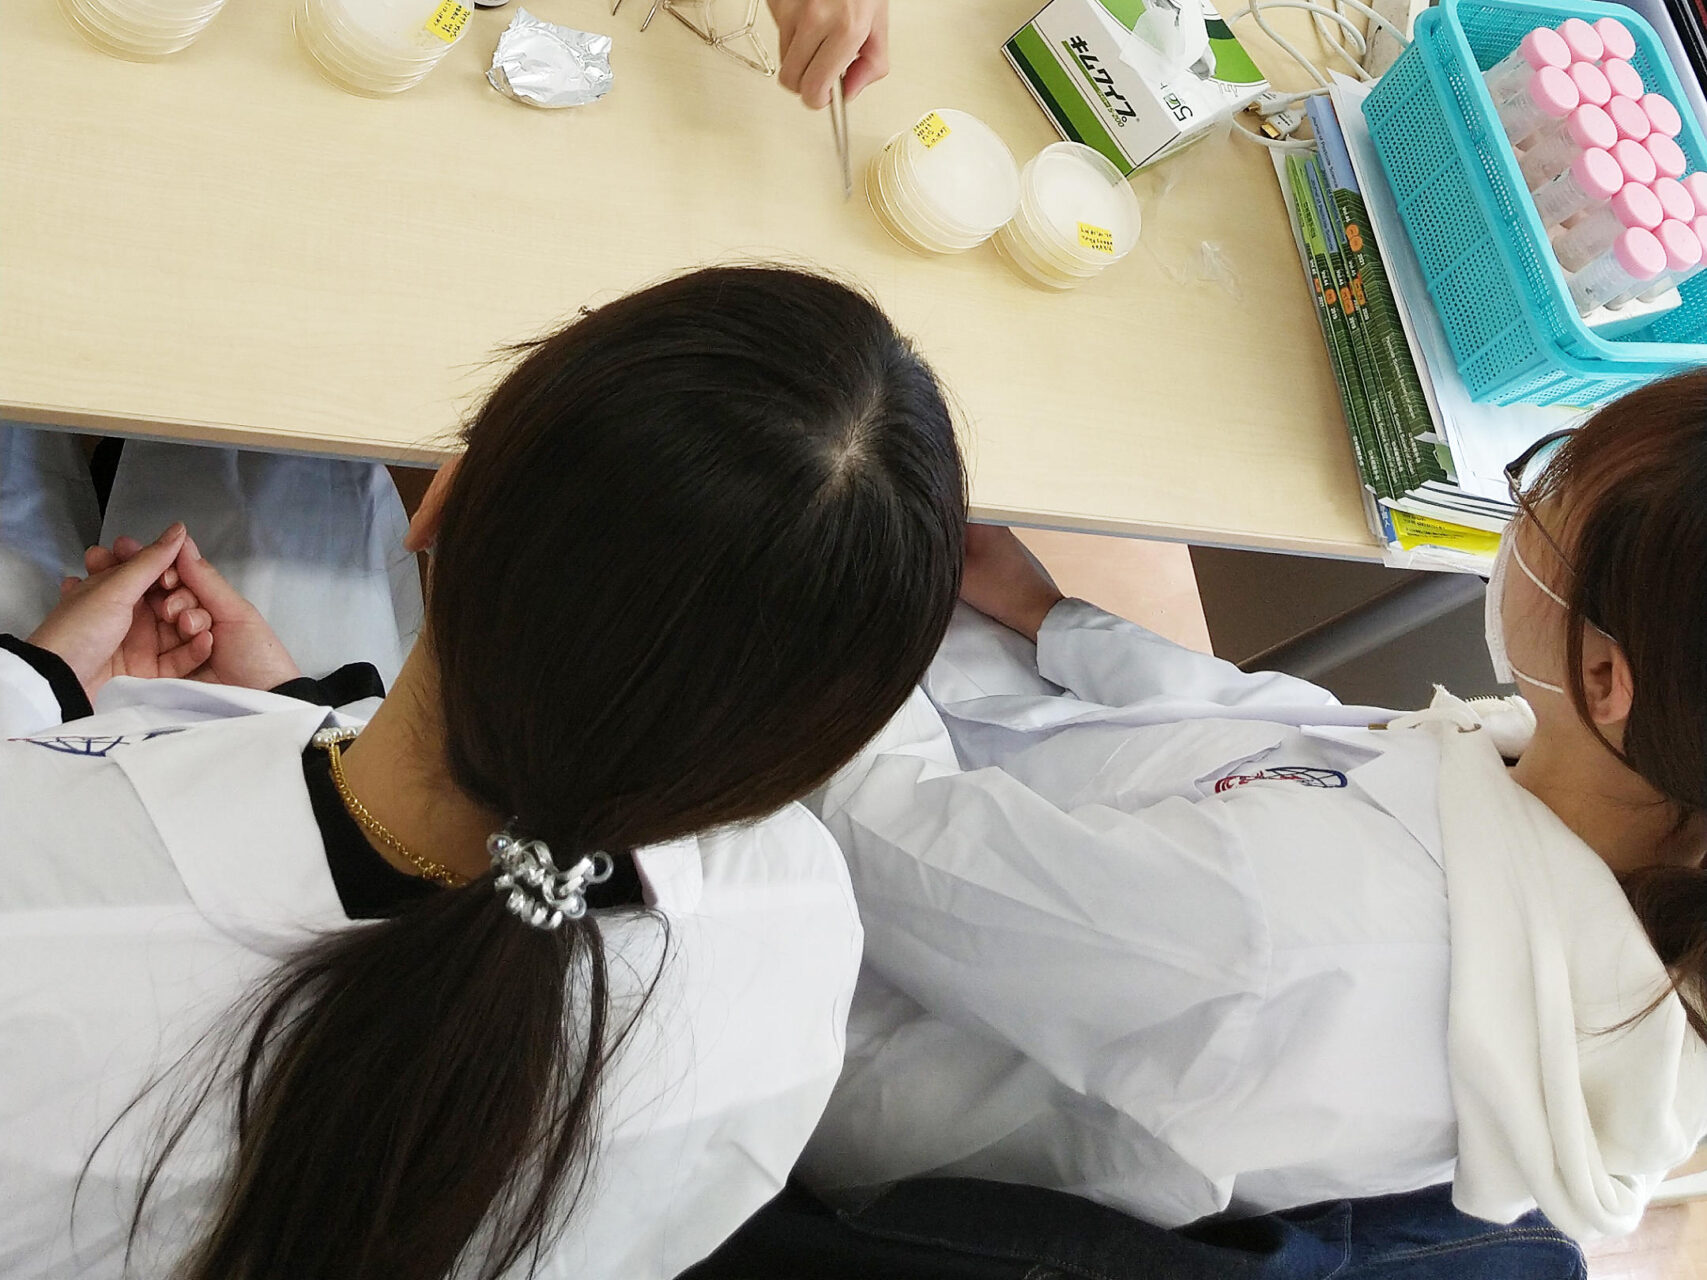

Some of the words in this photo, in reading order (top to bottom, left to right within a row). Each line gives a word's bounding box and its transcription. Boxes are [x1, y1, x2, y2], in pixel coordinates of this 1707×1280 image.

[1069, 35, 1137, 123] キムワイプ
